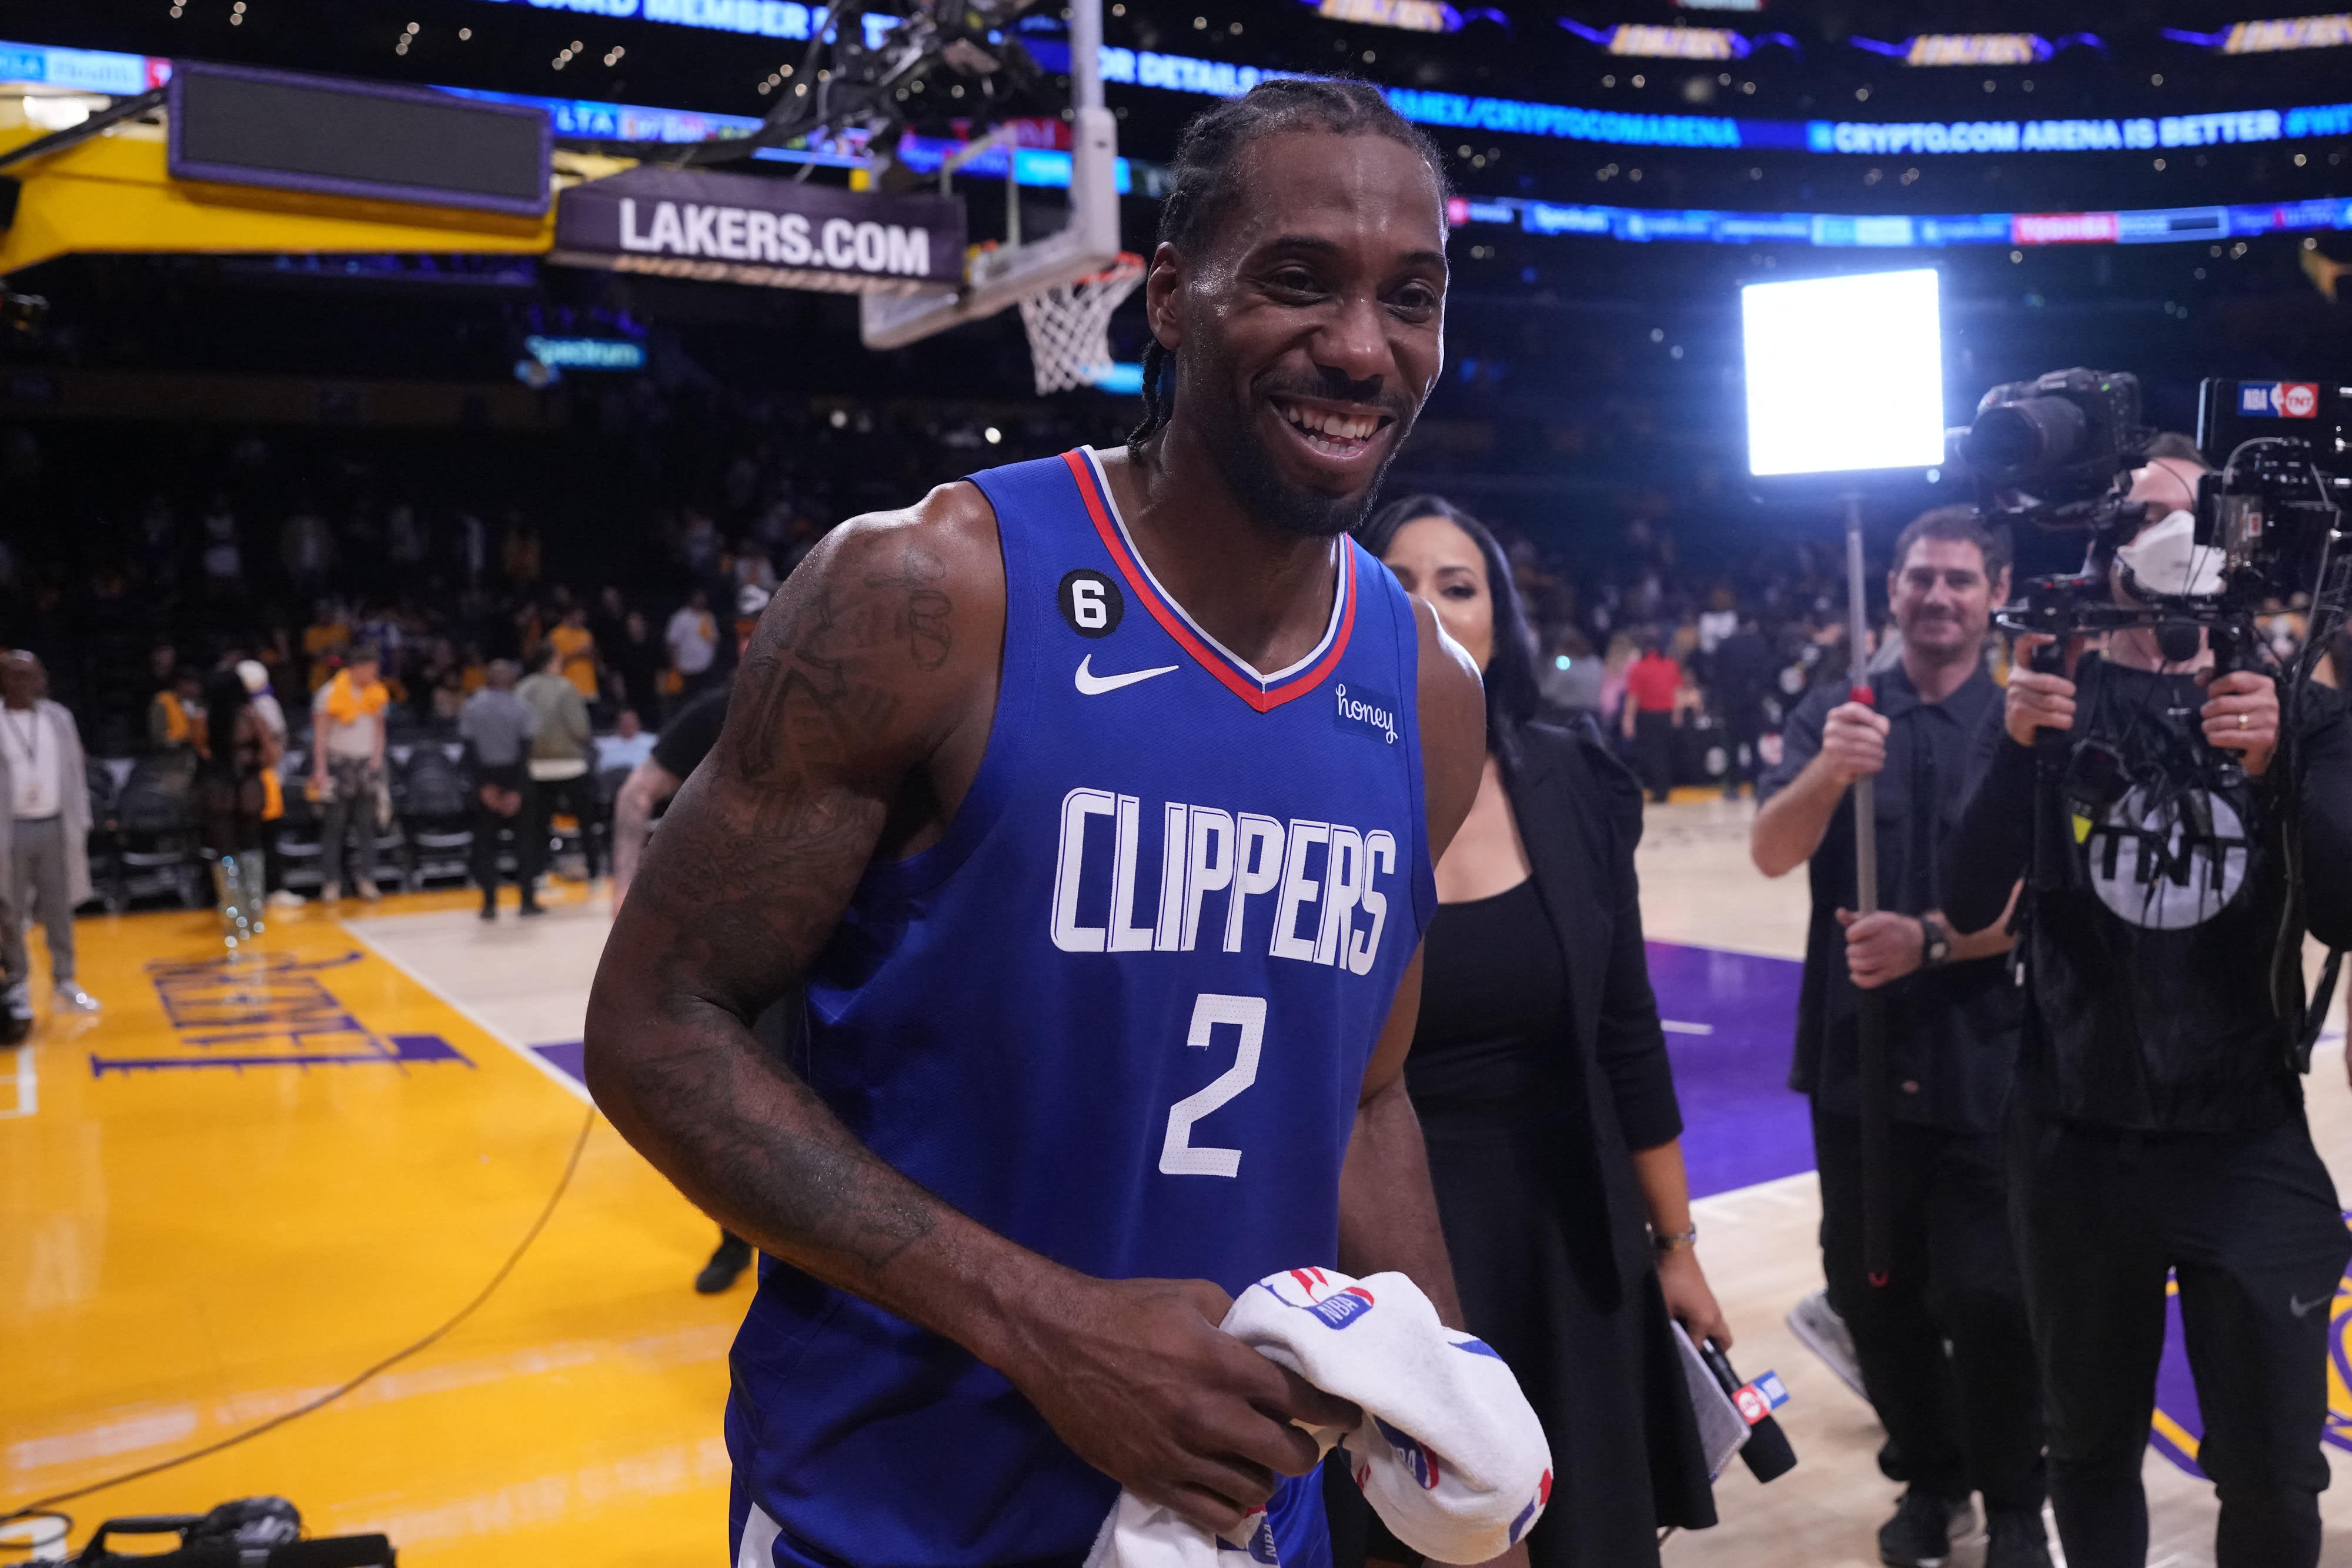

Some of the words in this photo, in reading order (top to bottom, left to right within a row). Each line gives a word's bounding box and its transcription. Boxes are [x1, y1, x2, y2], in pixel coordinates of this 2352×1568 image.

[643, 0, 809, 41] MEMBER
[1835, 121, 2020, 154] CRYPTO.COM
[2021, 119, 2122, 151] ARENA
[2123, 118, 2157, 149] IS
[2159, 109, 2282, 148] BETTER
[619, 198, 930, 276] LAKERS.COM
[525, 335, 642, 367] Spectrum
[1072, 580, 1107, 628] 6
[1335, 683, 1398, 744] honey
[1050, 787, 1396, 976] CLIPPERS
[1158, 994, 1267, 1178] 2
[1317, 1295, 1359, 1324] NBA
